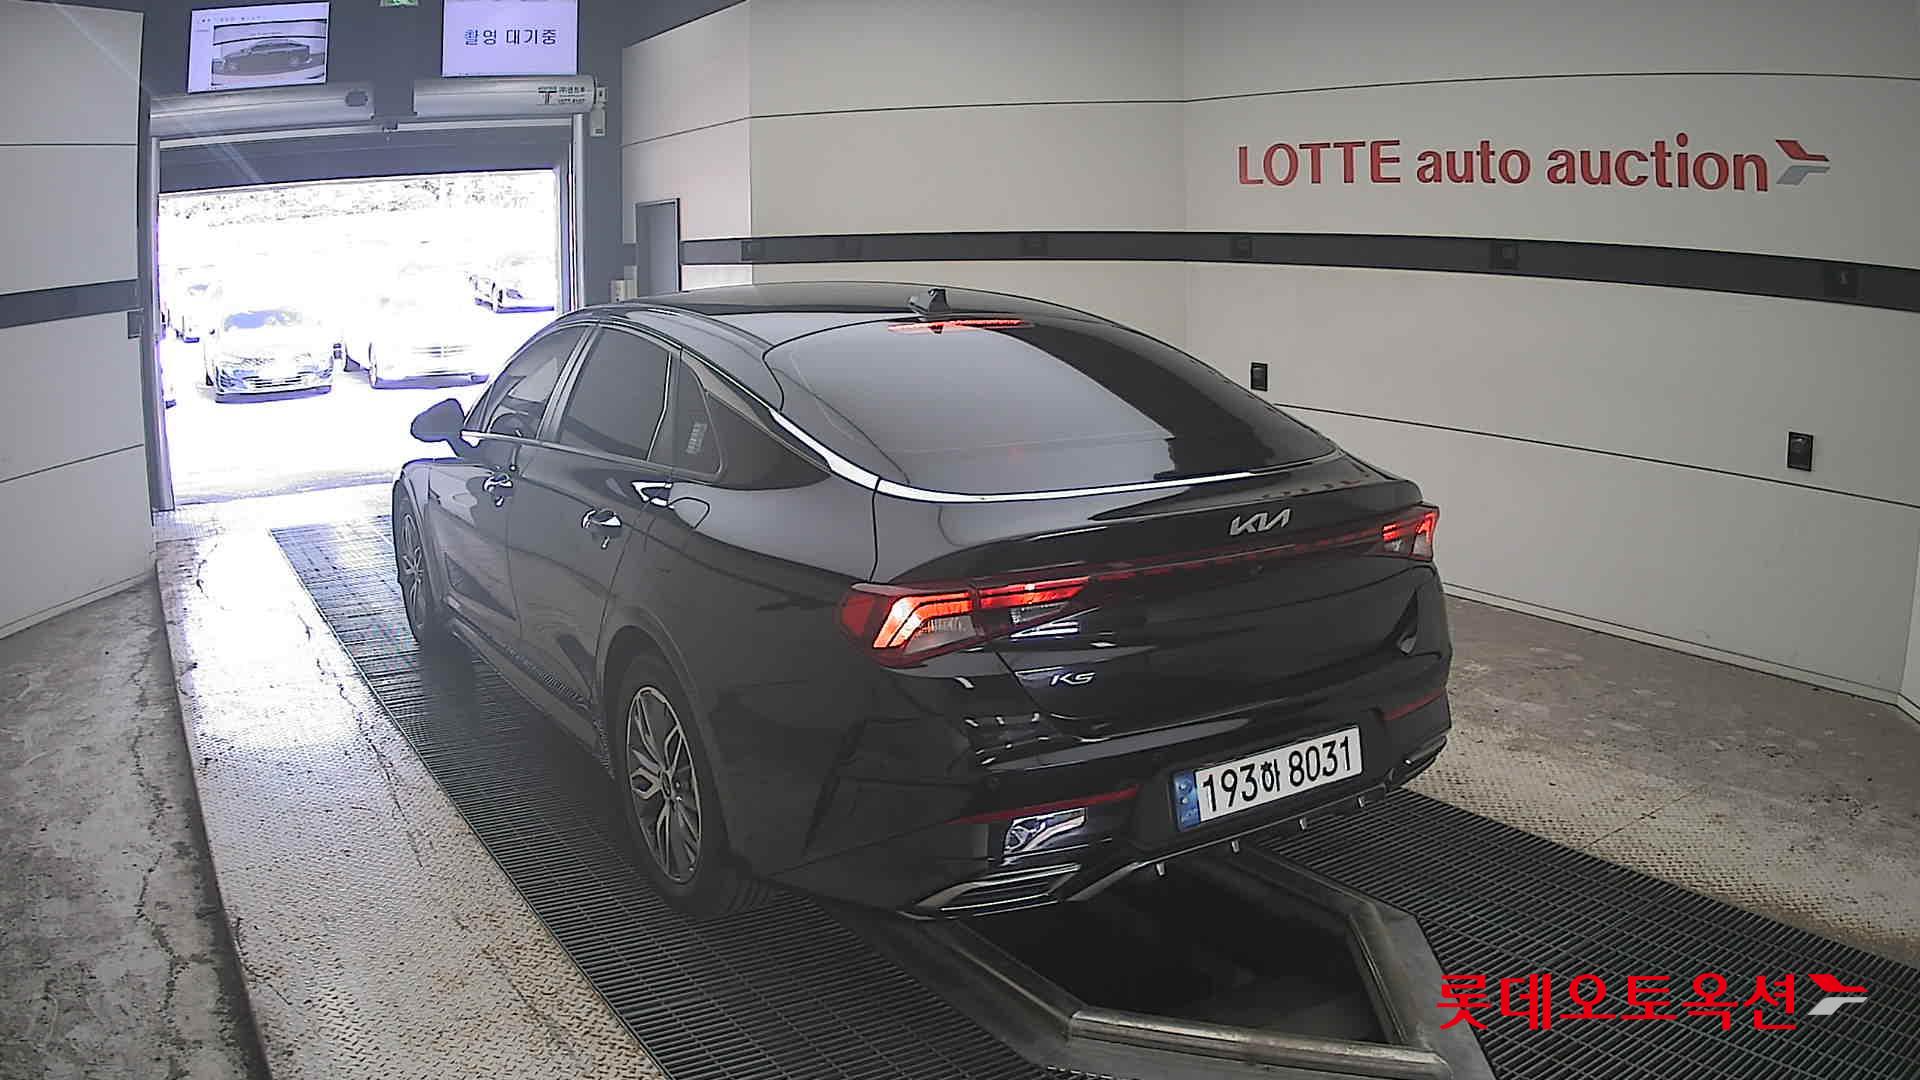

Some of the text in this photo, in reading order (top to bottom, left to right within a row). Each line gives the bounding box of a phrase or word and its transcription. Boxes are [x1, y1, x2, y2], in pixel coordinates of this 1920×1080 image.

[506, 28, 557, 46] 대기중
[1238, 132, 1768, 192] LOTTE auto auction
[1050, 671, 1096, 687] K5
[1202, 735, 1352, 813] 193하 8031
